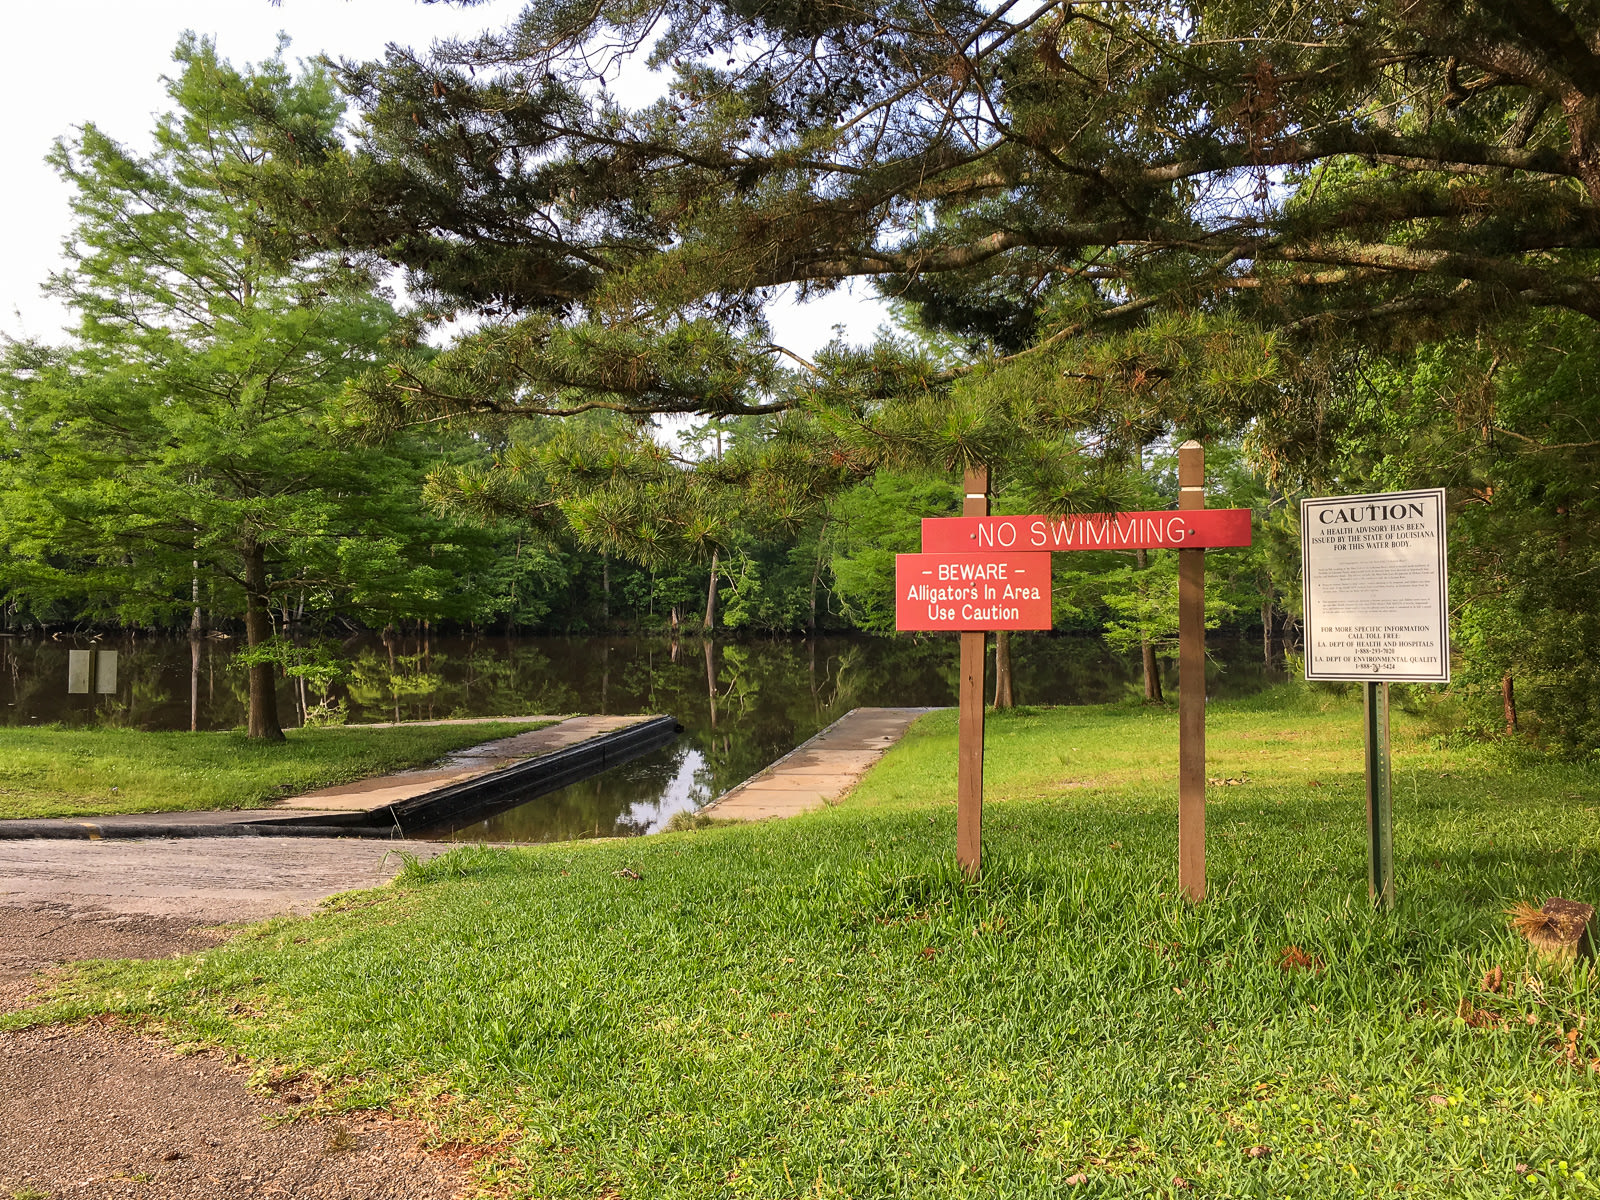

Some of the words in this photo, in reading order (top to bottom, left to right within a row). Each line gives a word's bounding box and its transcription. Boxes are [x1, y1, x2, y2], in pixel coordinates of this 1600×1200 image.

[1318, 502, 1424, 525] CAUTION
[978, 522, 1017, 547] NO
[1030, 517, 1186, 546] SWIMMING
[1326, 526, 1353, 536] HEALTH
[1355, 525, 1388, 534] ADVISORY
[1390, 523, 1405, 532] HAS
[1406, 522, 1425, 531] BEEN
[1312, 537, 1336, 545] ISSUED
[1348, 534, 1361, 542] THE
[1363, 533, 1384, 541] STATE
[1385, 532, 1395, 540] OF
[1396, 530, 1435, 539] LOUISIANA
[1334, 543, 1347, 551] FOR
[1348, 542, 1365, 550] THIS
[1366, 541, 1389, 549] WATER
[1391, 540, 1412, 548] BODY.
[938, 563, 1008, 581] BEWARE
[907, 584, 978, 604] Alligators
[984, 583, 996, 600] In
[1002, 583, 1041, 600] Area
[928, 603, 956, 620] Use
[961, 603, 1019, 620] Caution
[1354, 625, 1382, 633] SPECIFIC
[1398, 640, 1434, 648] HOSPITALS
[1409, 656, 1438, 664] QUALITY
